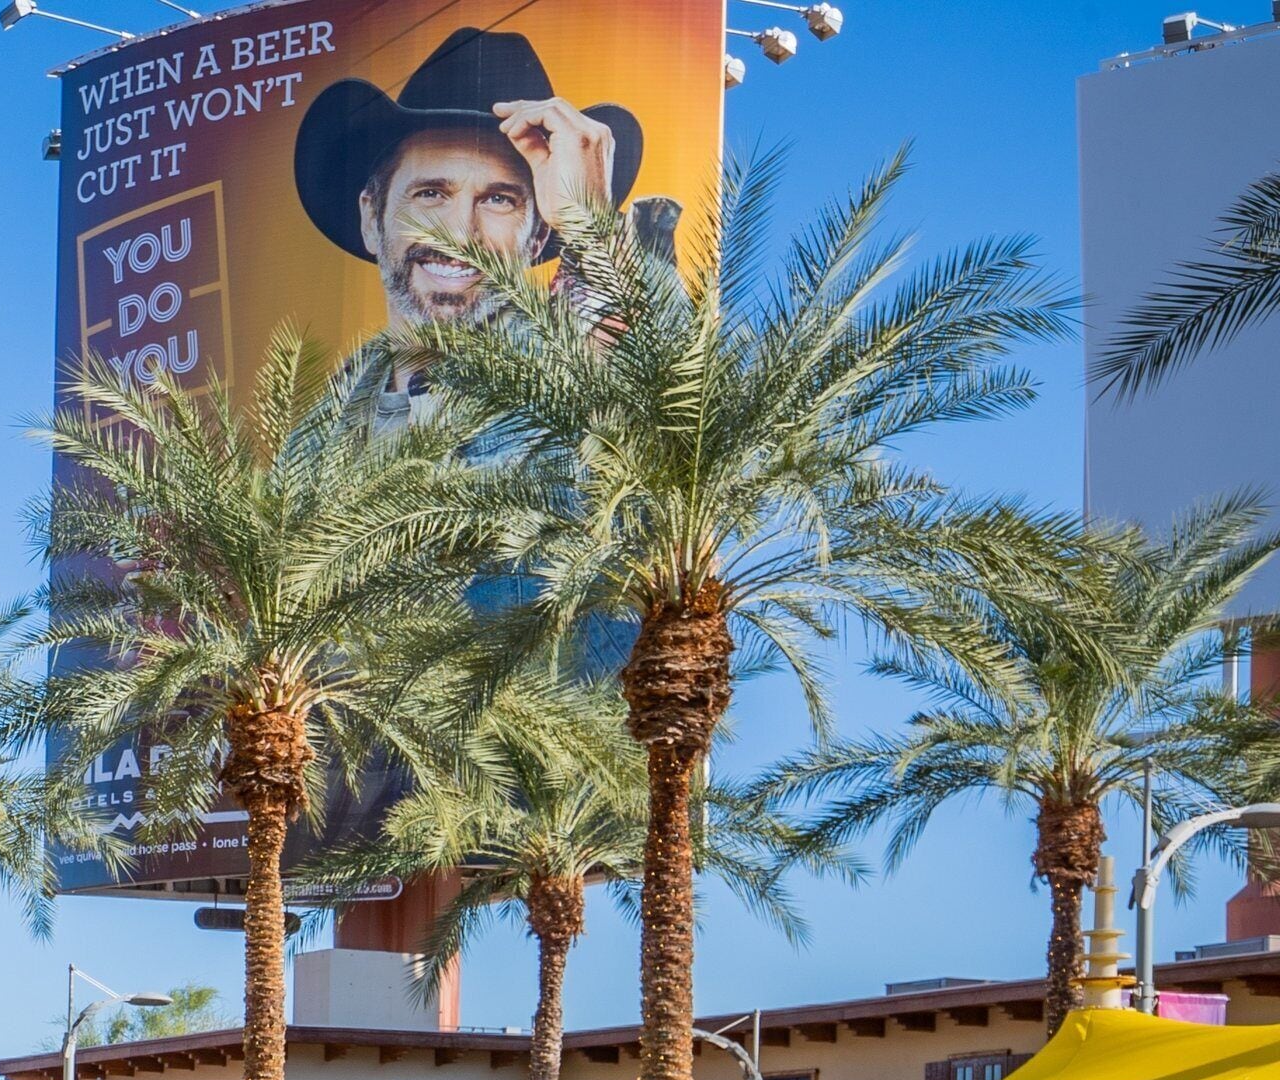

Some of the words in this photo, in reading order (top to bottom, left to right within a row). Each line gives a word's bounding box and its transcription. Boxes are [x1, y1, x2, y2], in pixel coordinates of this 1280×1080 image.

[78, 48, 186, 115] WHEN
[192, 46, 220, 81] A
[230, 20, 337, 70] BEER
[76, 103, 156, 161] JUST
[164, 71, 303, 127] WON'T
[75, 151, 144, 203] CUT
[150, 141, 188, 182] IT
[102, 216, 192, 285] YOU
[117, 280, 183, 337] DO
[107, 329, 199, 390] YOU
[58, 853, 76, 866] vee
[76, 850, 102, 866] quiva
[171, 839, 197, 855] pass
[212, 836, 238, 849] lone
